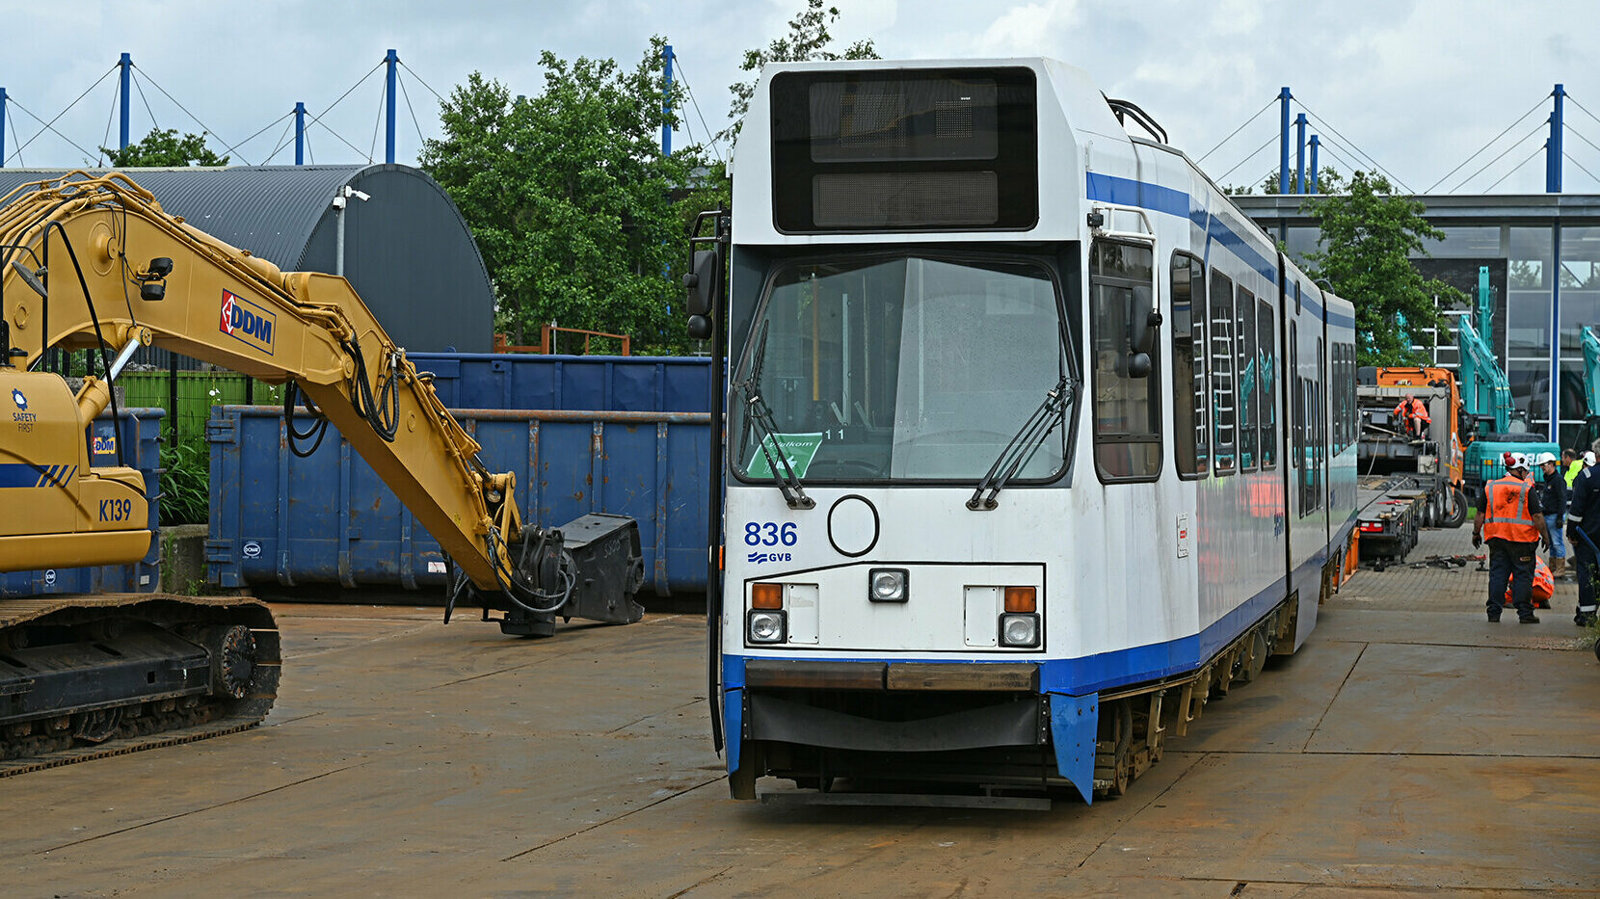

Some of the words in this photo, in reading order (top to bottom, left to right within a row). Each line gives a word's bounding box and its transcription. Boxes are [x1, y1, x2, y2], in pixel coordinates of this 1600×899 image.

[231, 304, 272, 344] DDM
[12, 412, 37, 422] SAFETY
[17, 423, 34, 433] FIRST
[95, 440, 114, 451] DDM
[99, 498, 132, 522] K139
[744, 521, 798, 547] 836
[768, 553, 792, 562] GVB
